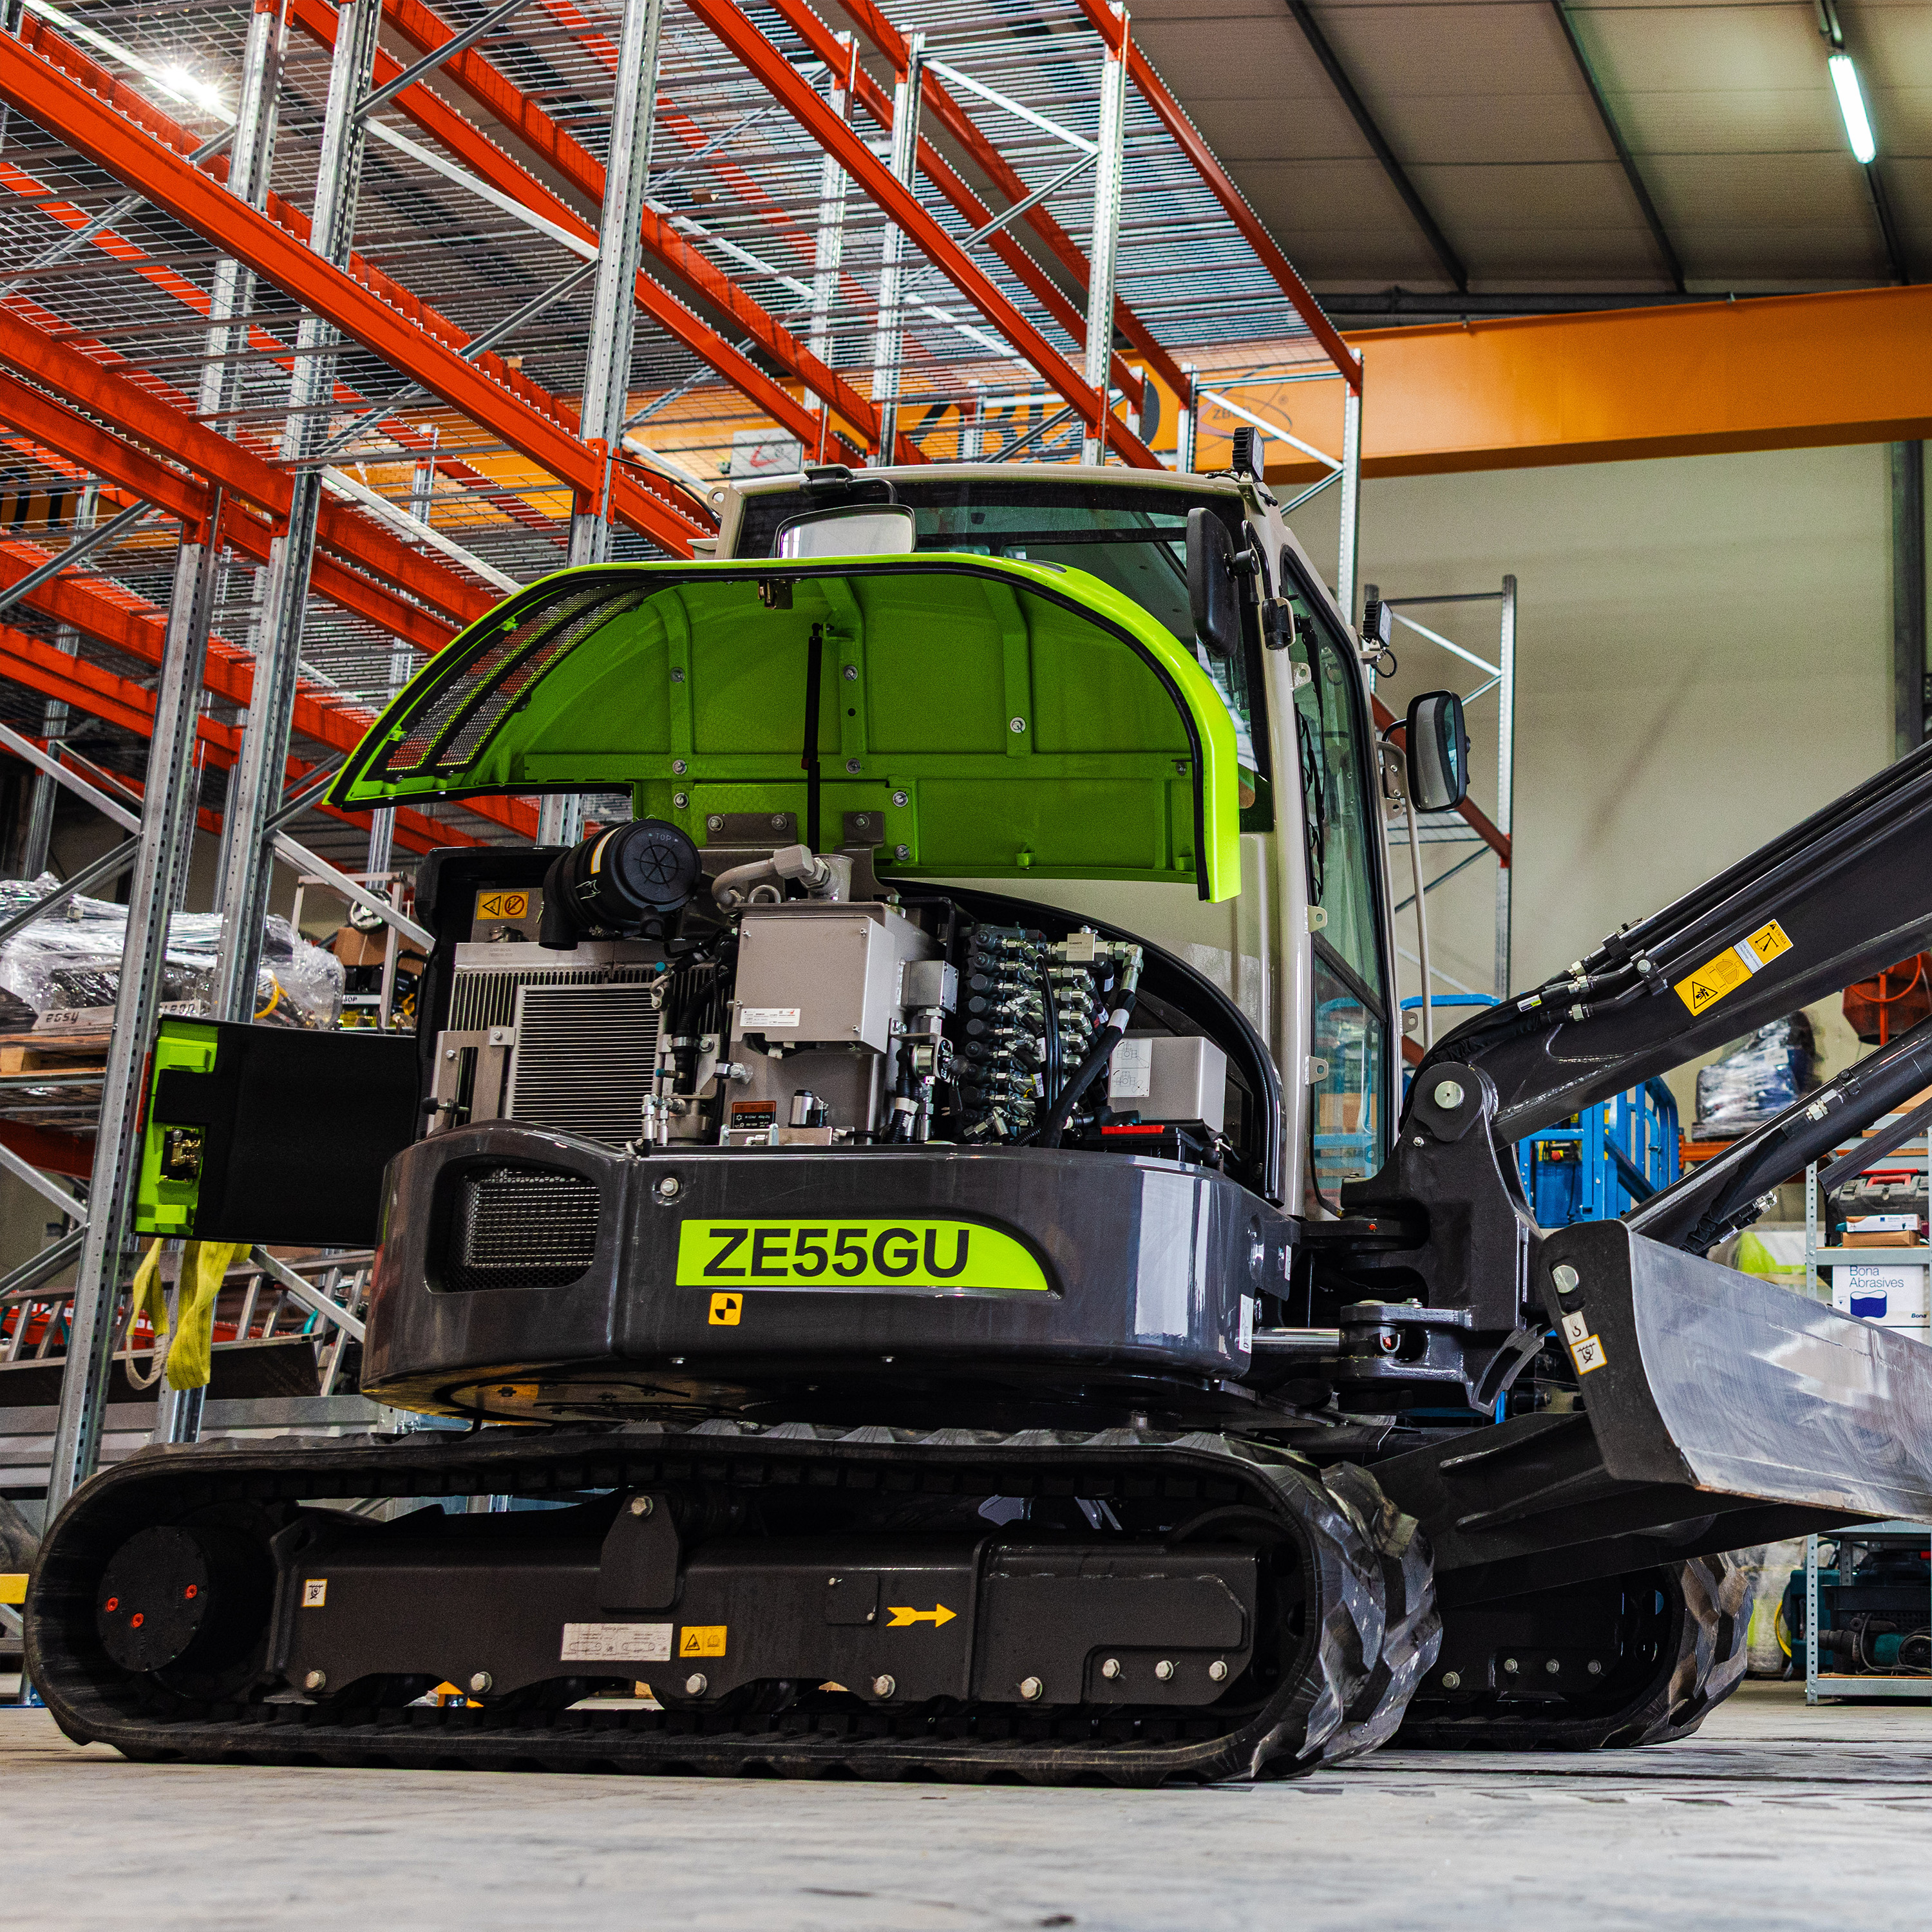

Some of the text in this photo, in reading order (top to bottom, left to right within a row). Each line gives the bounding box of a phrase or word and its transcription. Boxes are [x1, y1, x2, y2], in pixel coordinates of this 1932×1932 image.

[656, 833, 672, 841] TOP
[1775, 929, 1787, 945] UWAGA
[703, 1227, 970, 1278] ZE55GU
[1850, 1265, 1880, 1276] Bona
[1849, 1277, 1904, 1288] Abrasives
